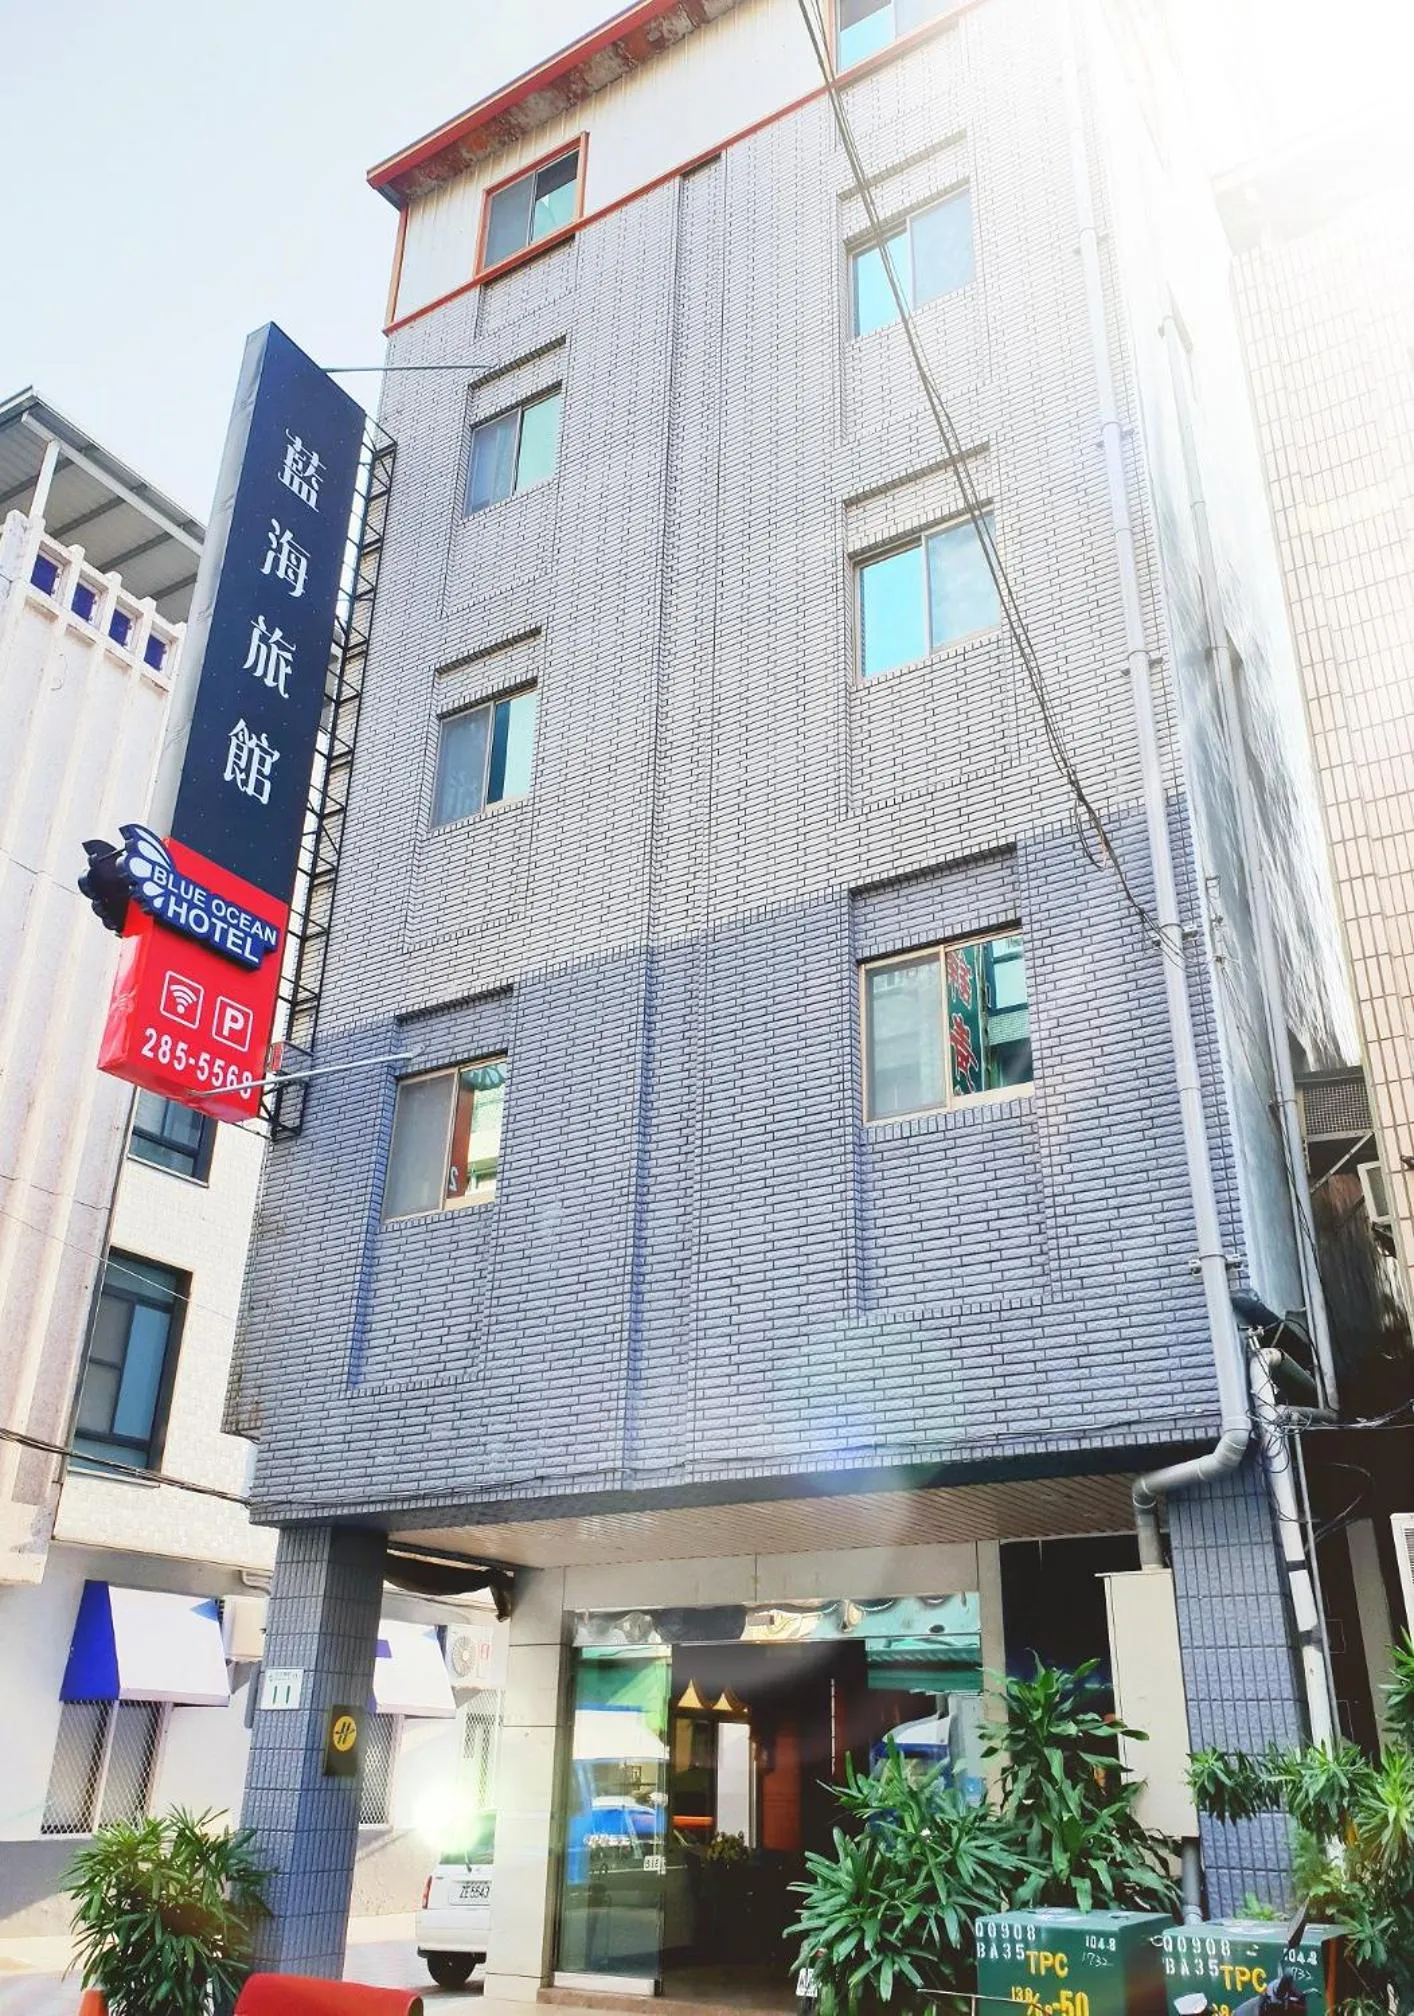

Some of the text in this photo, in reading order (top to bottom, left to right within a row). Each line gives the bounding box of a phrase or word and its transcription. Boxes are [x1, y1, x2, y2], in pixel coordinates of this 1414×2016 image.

[223, 428, 326, 805] 藍海旅館
[153, 865, 277, 946] BLUE OCEAN
[167, 895, 259, 963] HOTEL
[222, 1006, 244, 1037] P
[141, 1028, 252, 1099] 285-5568
[272, 1685, 290, 1704] 11
[977, 1942, 1025, 1960] BA35
[1026, 1950, 1069, 1978] TPC
[1165, 1958, 1219, 1977] BA35
[1220, 1965, 1268, 1993] TPC
